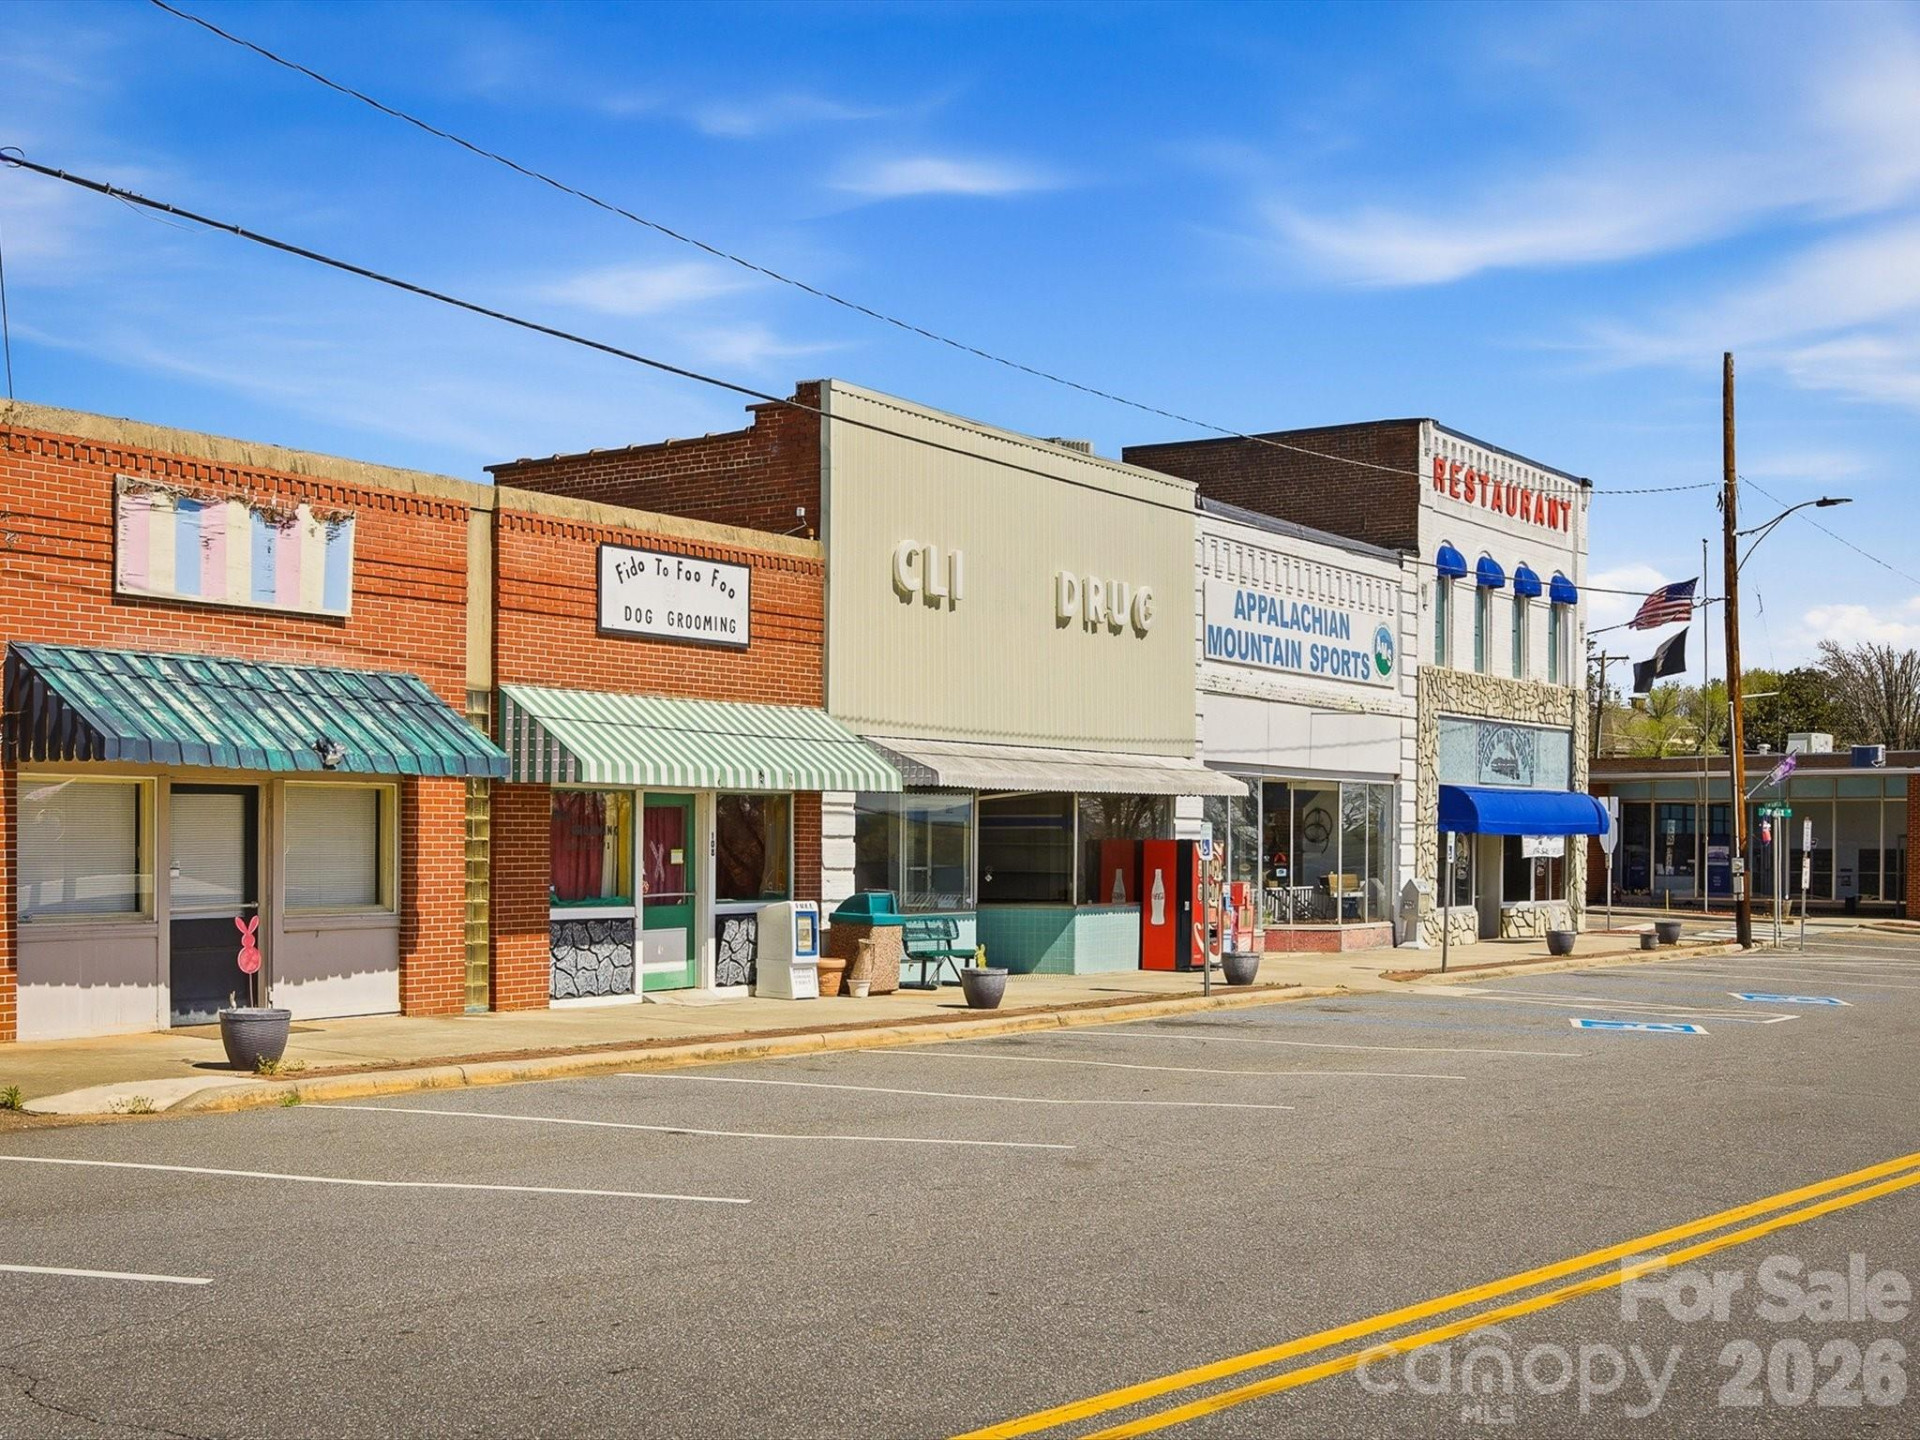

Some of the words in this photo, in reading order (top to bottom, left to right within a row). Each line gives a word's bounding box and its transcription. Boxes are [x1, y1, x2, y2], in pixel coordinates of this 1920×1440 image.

[1433, 455, 1571, 533] RESTAURANT
[615, 556, 645, 584] Fido
[655, 558, 669, 577] To
[677, 560, 701, 583] Foo
[711, 568, 735, 599] Foo
[893, 539, 963, 602] CLI
[624, 605, 653, 624] DOG
[667, 611, 736, 634] GROOMING
[1055, 570, 1155, 632] DRUG
[1234, 590, 1350, 640] APPALACHIAN
[1207, 624, 1302, 669] MOUNTAIN
[1309, 643, 1370, 680] SPORTS
